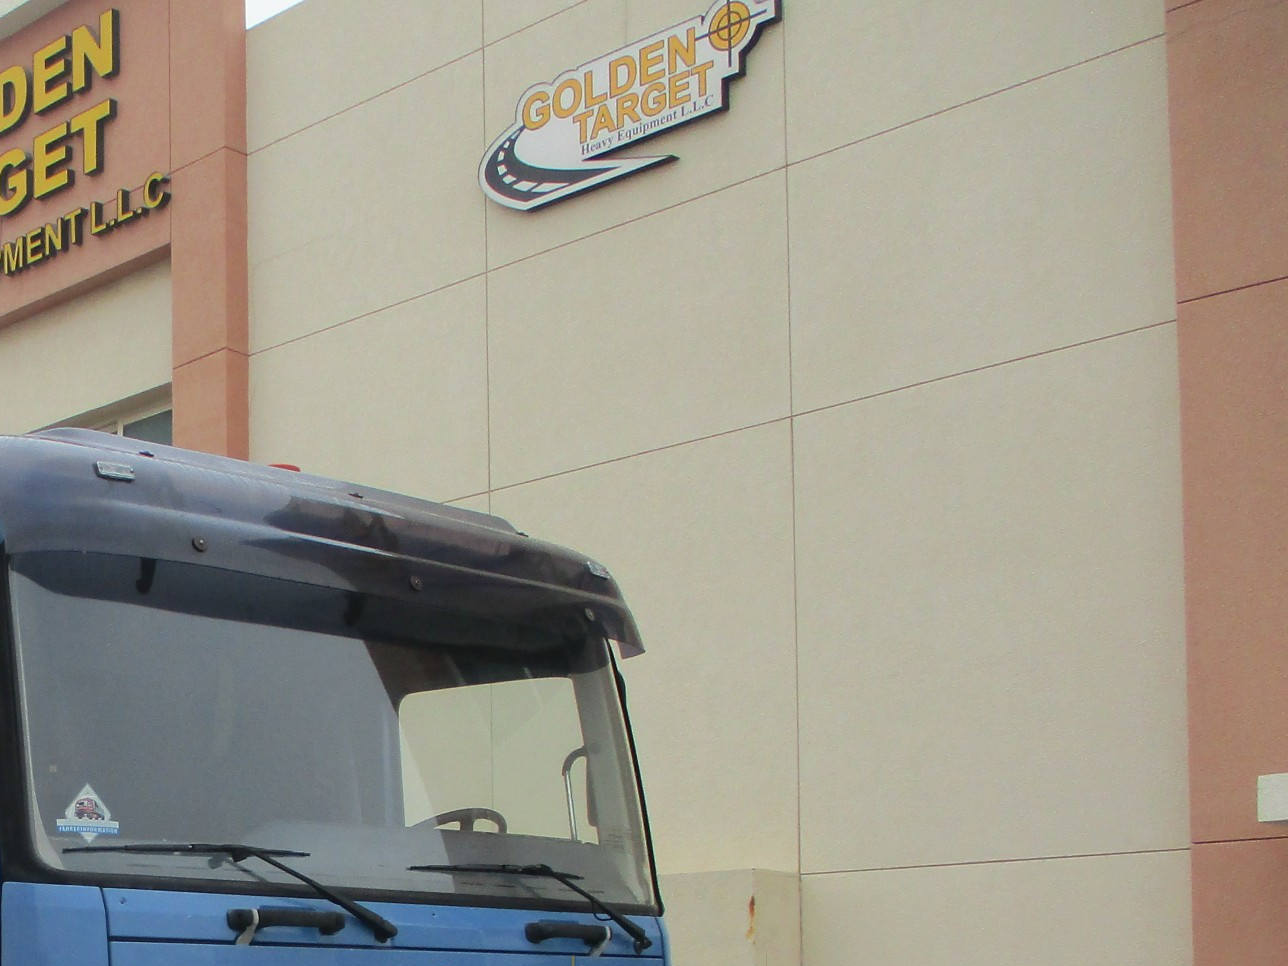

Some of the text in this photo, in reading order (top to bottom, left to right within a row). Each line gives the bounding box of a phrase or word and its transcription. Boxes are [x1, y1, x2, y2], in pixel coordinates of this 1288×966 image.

[522, 27, 696, 130] GOLDEN
[573, 60, 714, 144] TARGET
[581, 136, 614, 155] Heavy
[617, 111, 678, 140] Equipment
[90, 172, 171, 236] L.L.C
